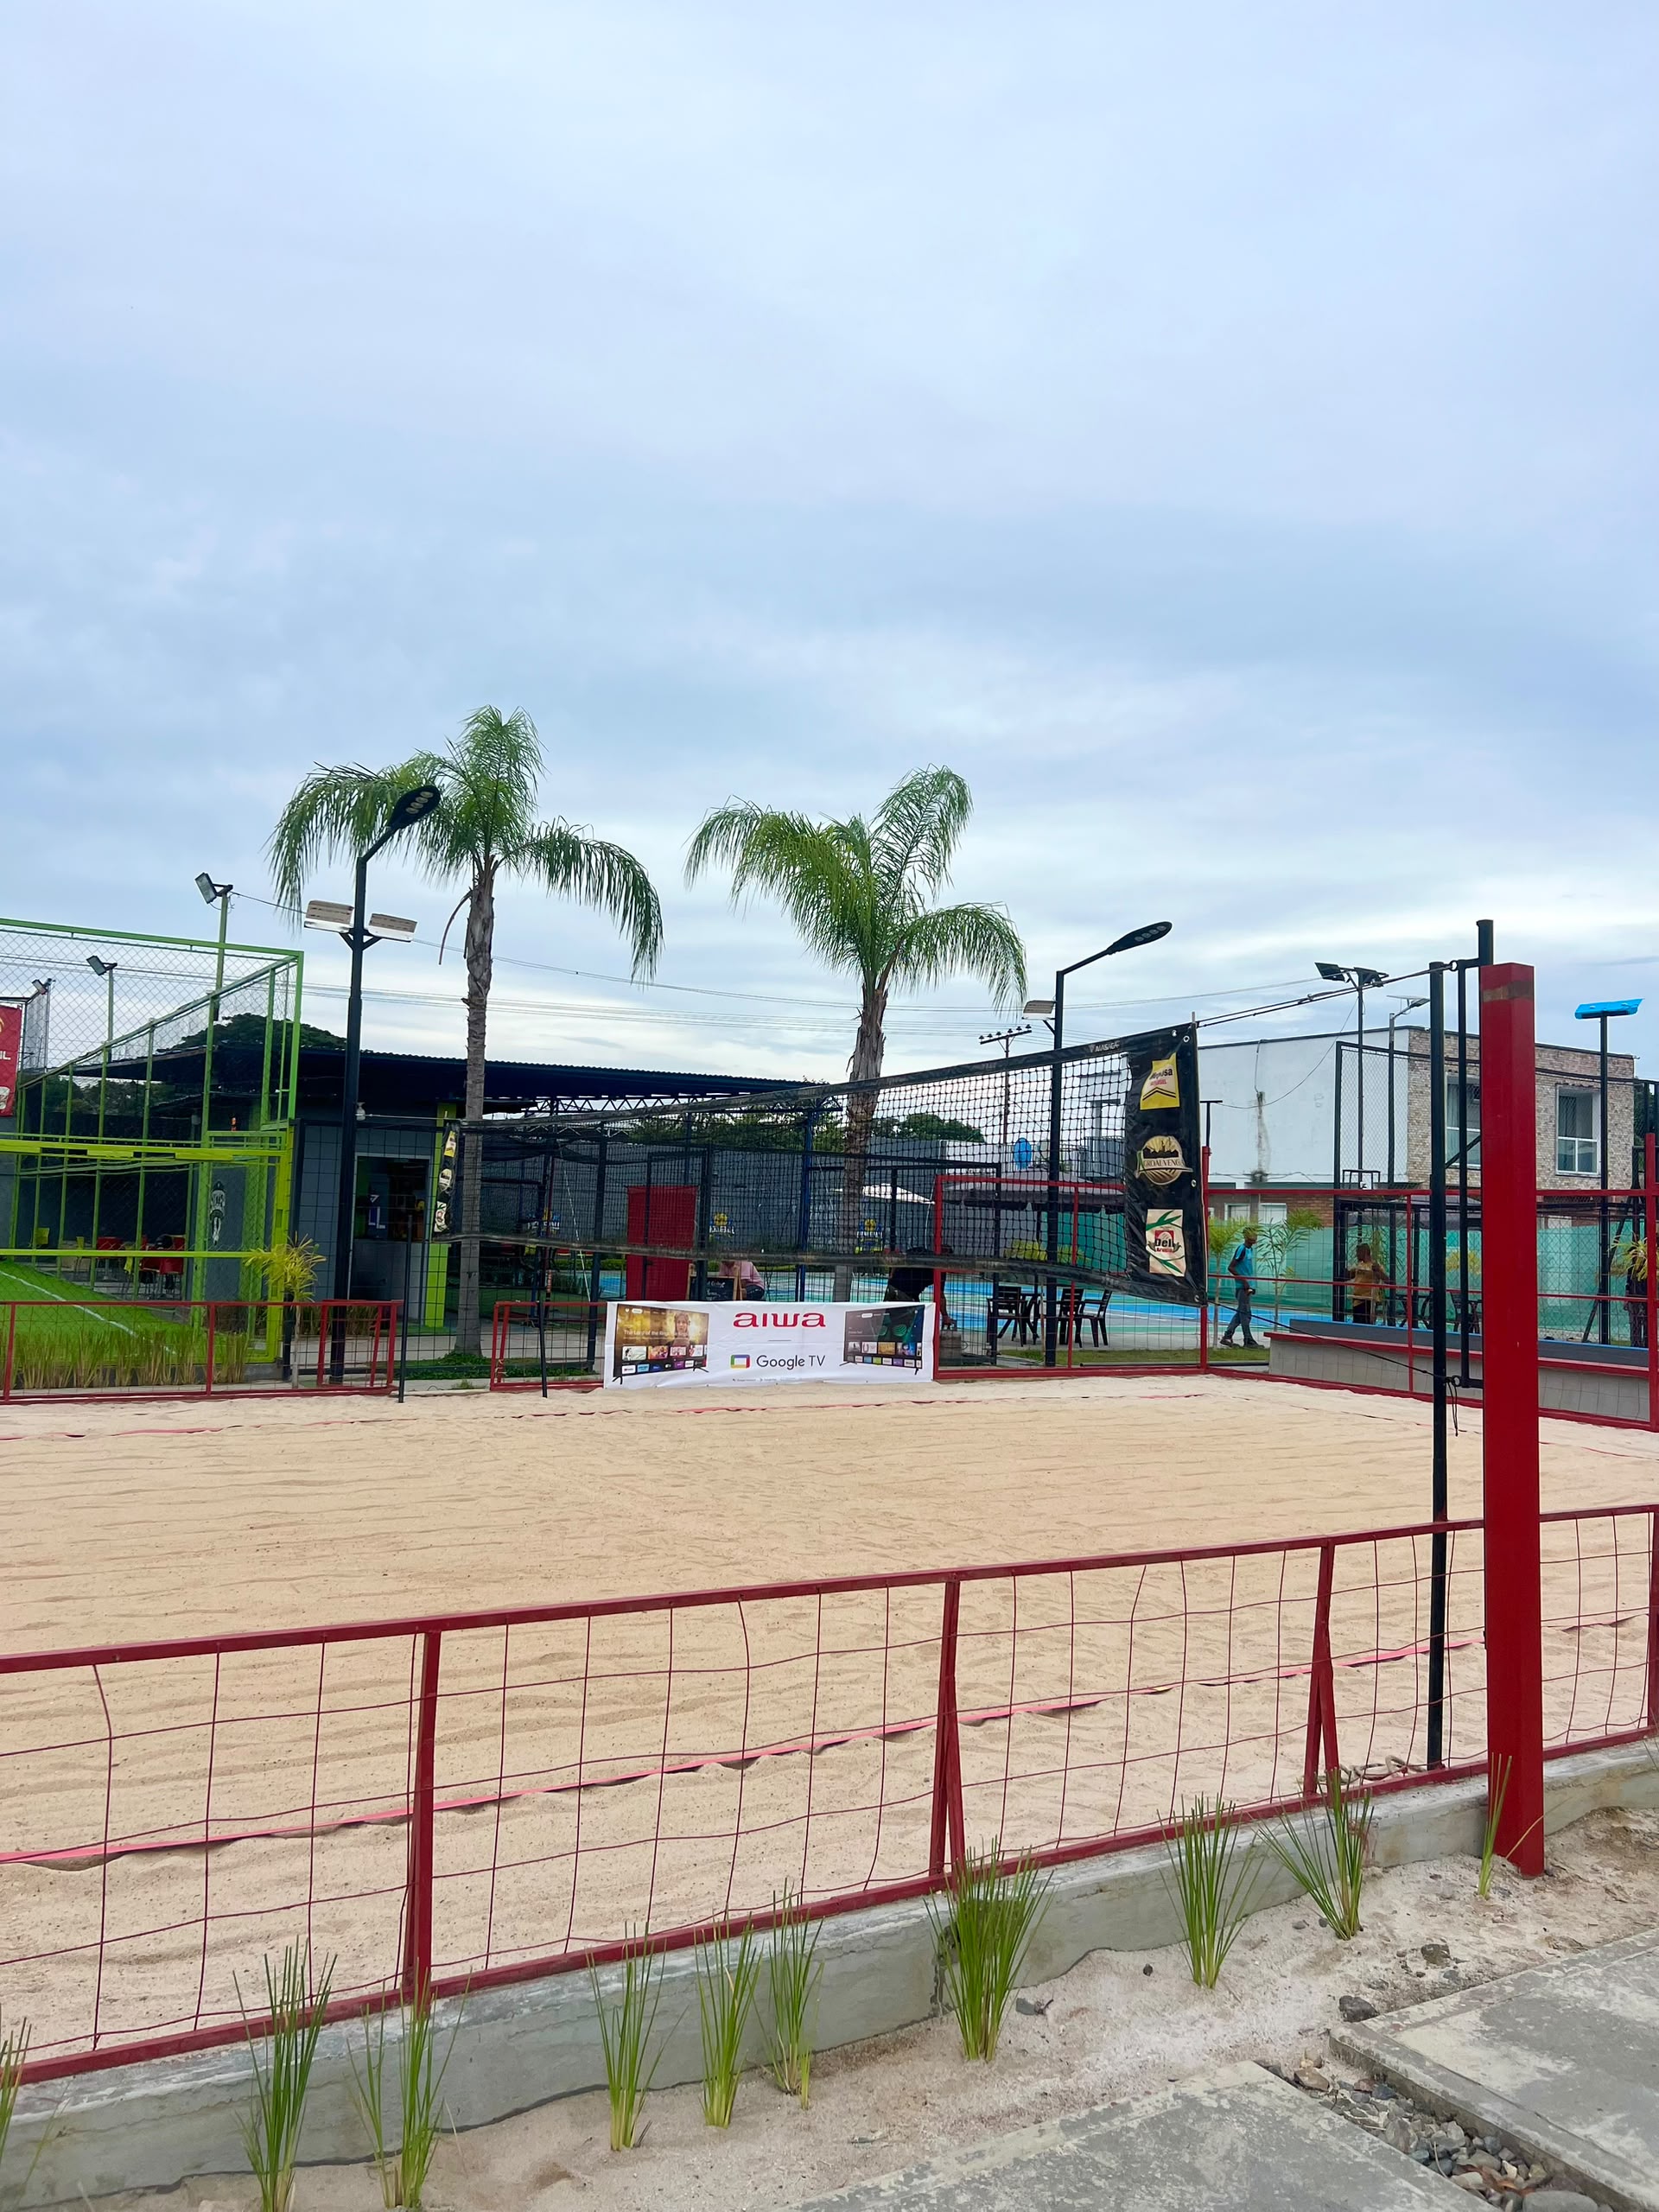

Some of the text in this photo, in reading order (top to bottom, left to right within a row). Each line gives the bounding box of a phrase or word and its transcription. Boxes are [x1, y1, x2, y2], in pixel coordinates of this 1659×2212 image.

[733, 1313, 826, 1328] aiwa
[756, 1355, 826, 1370] Google TV
